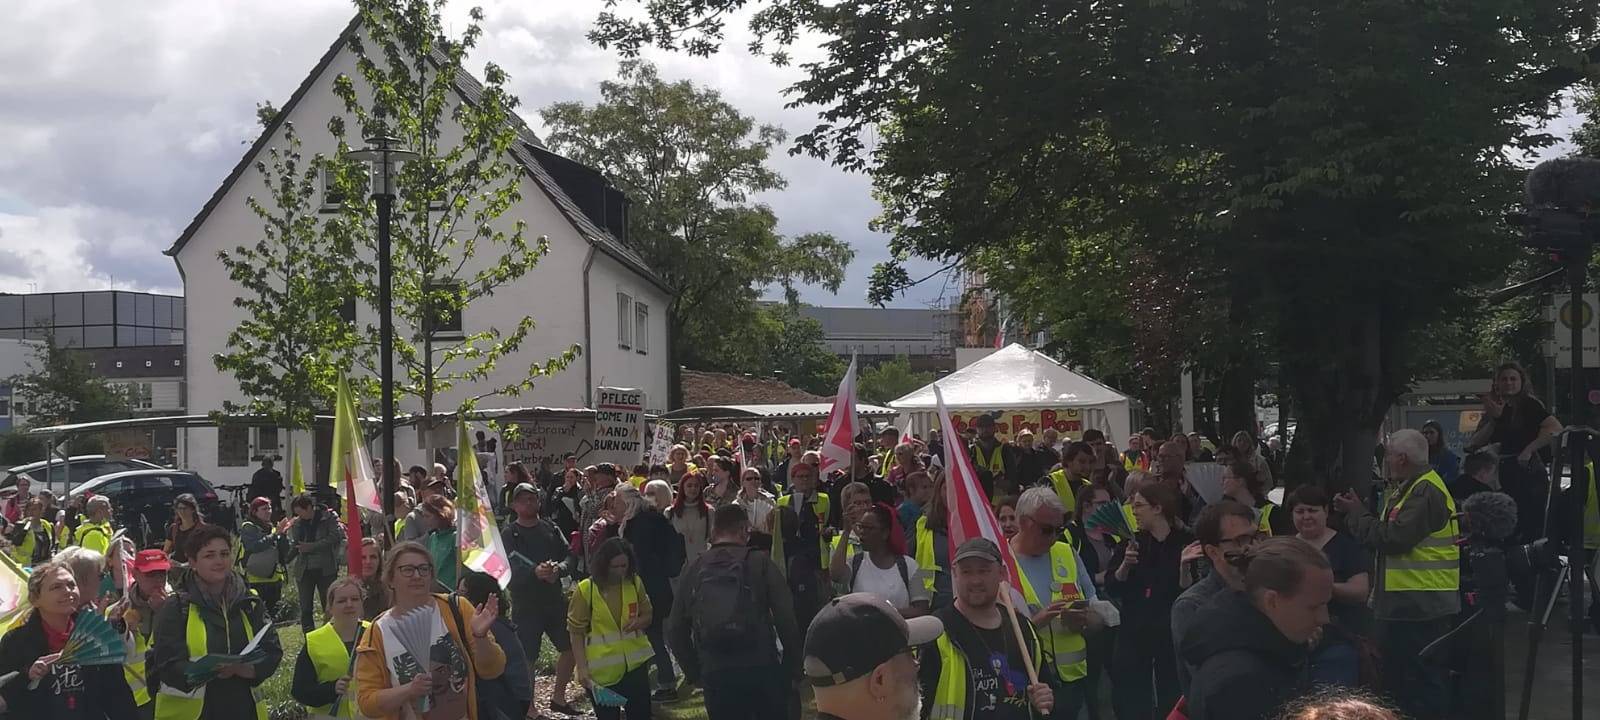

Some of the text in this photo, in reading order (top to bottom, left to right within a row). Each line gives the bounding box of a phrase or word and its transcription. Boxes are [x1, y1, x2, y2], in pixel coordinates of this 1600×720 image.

[601, 392, 640, 405] PFLEGE
[596, 411, 637, 424] COME IN
[606, 426, 628, 438] AND
